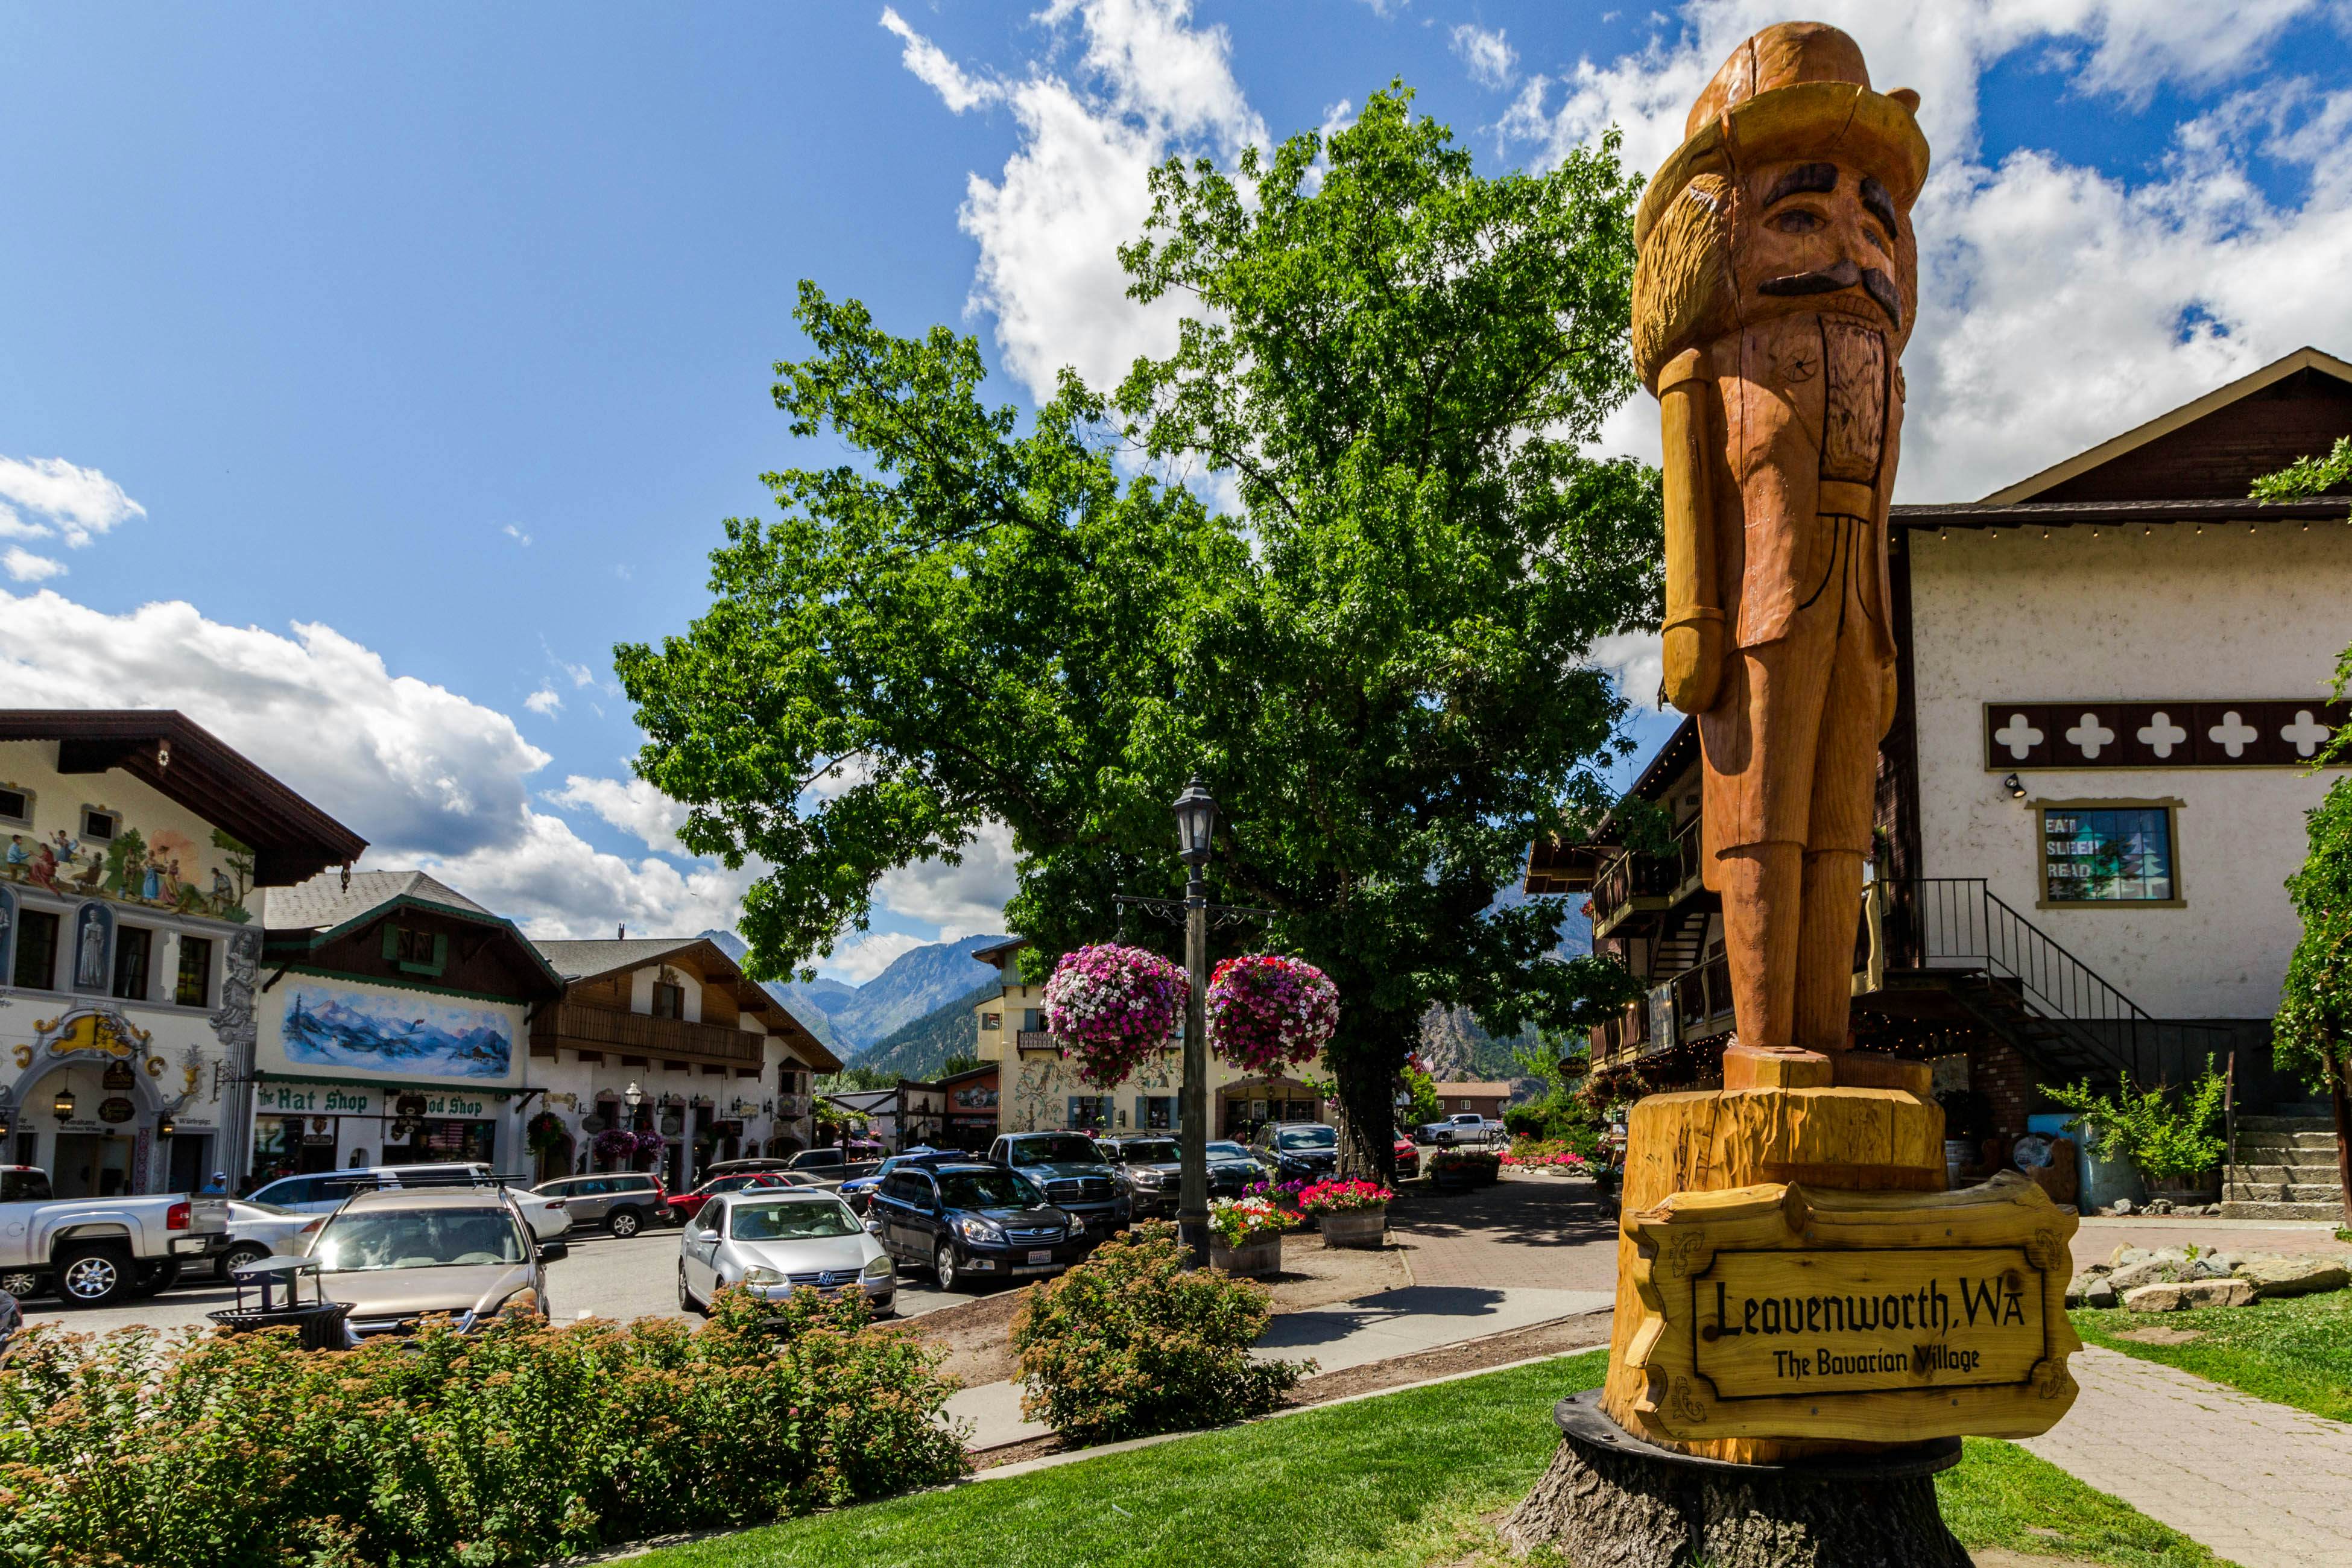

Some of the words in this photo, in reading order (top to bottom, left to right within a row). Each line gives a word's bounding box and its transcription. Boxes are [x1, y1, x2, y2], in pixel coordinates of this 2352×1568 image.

[2045, 819, 2076, 833] EAT
[2046, 840, 2099, 855] SLEEP
[2047, 863, 2091, 877] READ
[277, 1087, 316, 1110] Hat
[324, 1089, 367, 1114] Shop
[448, 1095, 482, 1117] Shop
[1716, 1278, 1959, 1337] Leavenworth,
[1959, 1277, 2025, 1328] WA
[1772, 1350, 1811, 1381] The
[1816, 1348, 1908, 1376] Bavarian
[1912, 1344, 1981, 1373] Village
